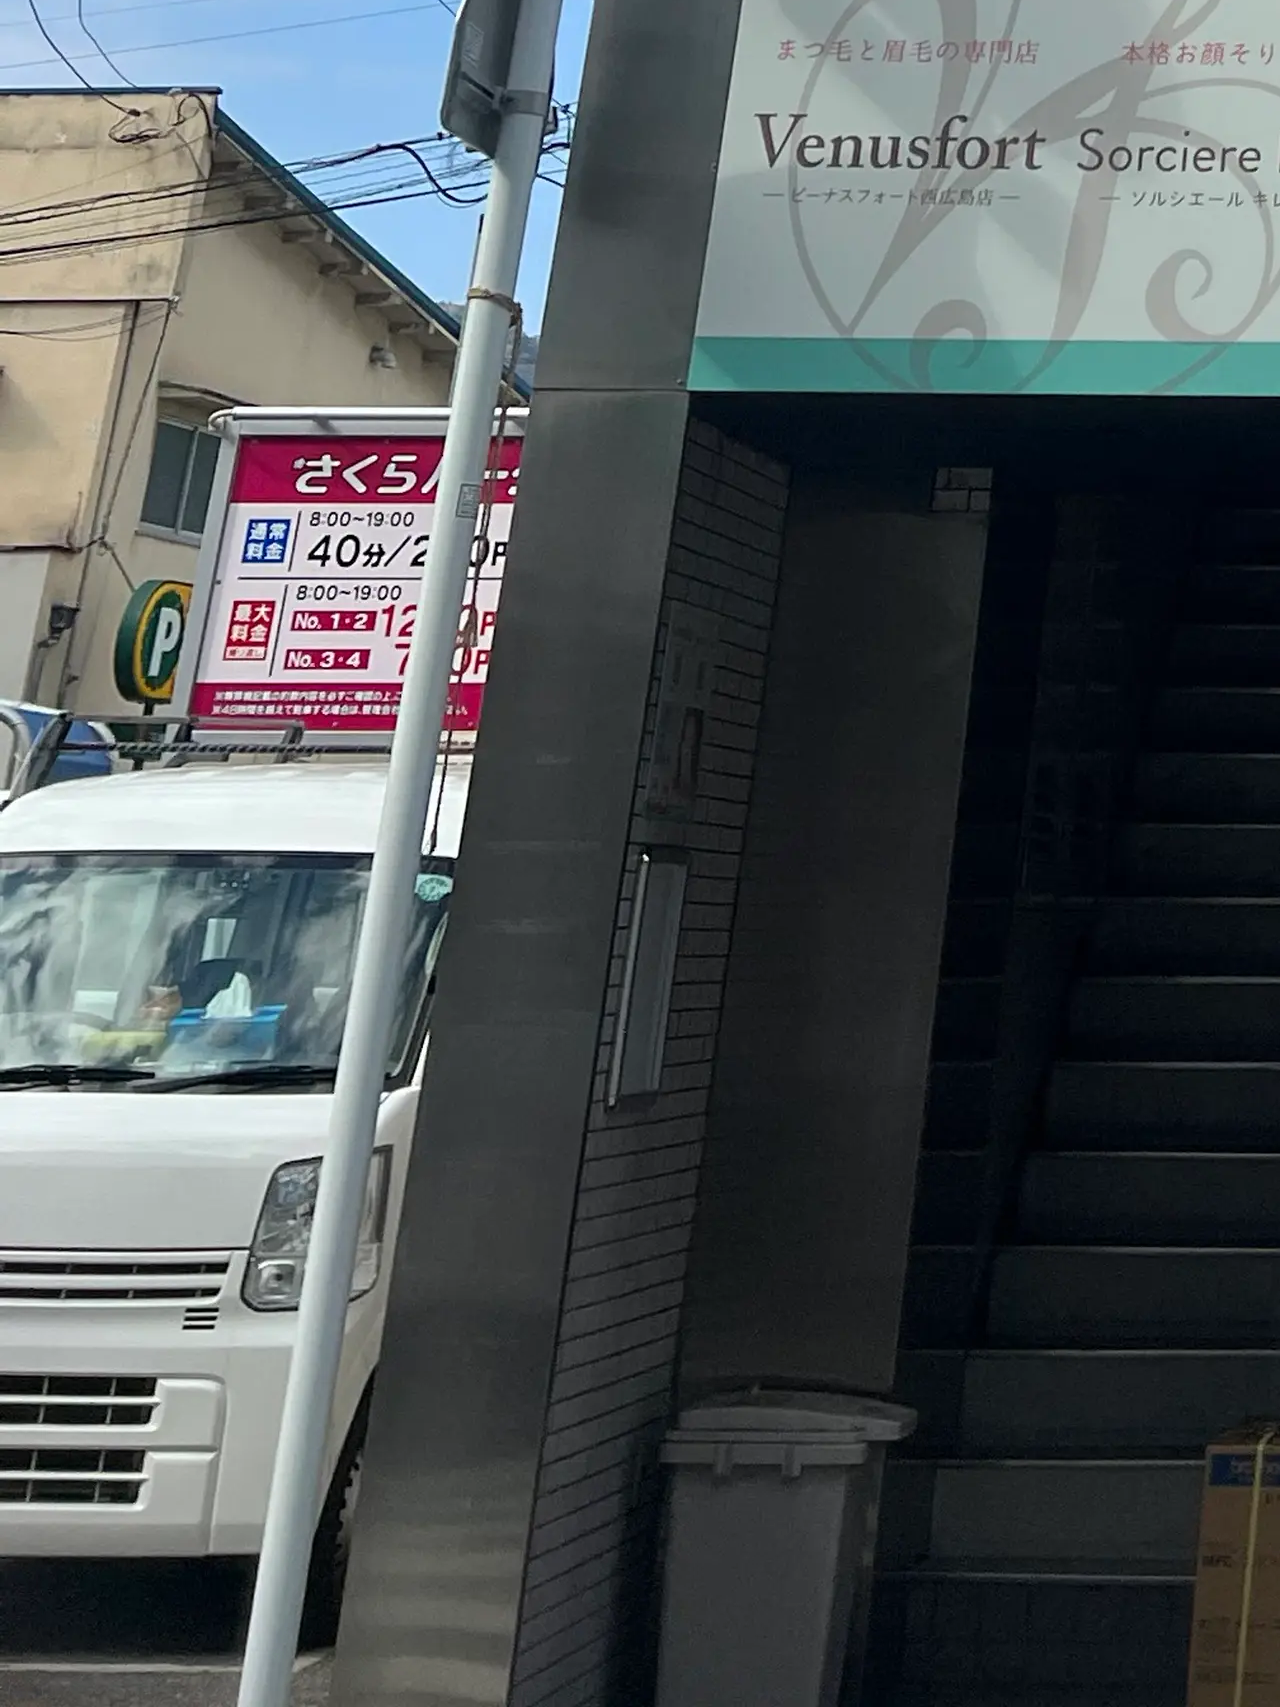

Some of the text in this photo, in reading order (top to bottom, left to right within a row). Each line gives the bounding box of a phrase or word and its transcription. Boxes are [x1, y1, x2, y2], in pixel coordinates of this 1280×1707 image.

[776, 38, 1041, 67] まつ毛と眉毛の専門店
[754, 111, 1047, 172] Venusfort
[1075, 128, 1262, 176] Sorciere
[789, 186, 995, 208] ビーナスフォート西広島店
[1130, 188, 1244, 210] ソルシエール
[247, 521, 290, 541] 通常
[244, 542, 287, 562] 料金
[232, 603, 271, 623] 最大
[293, 612, 322, 631] No.
[148, 605, 180, 678] P
[229, 624, 268, 643] 料金
[286, 650, 316, 669] No.
